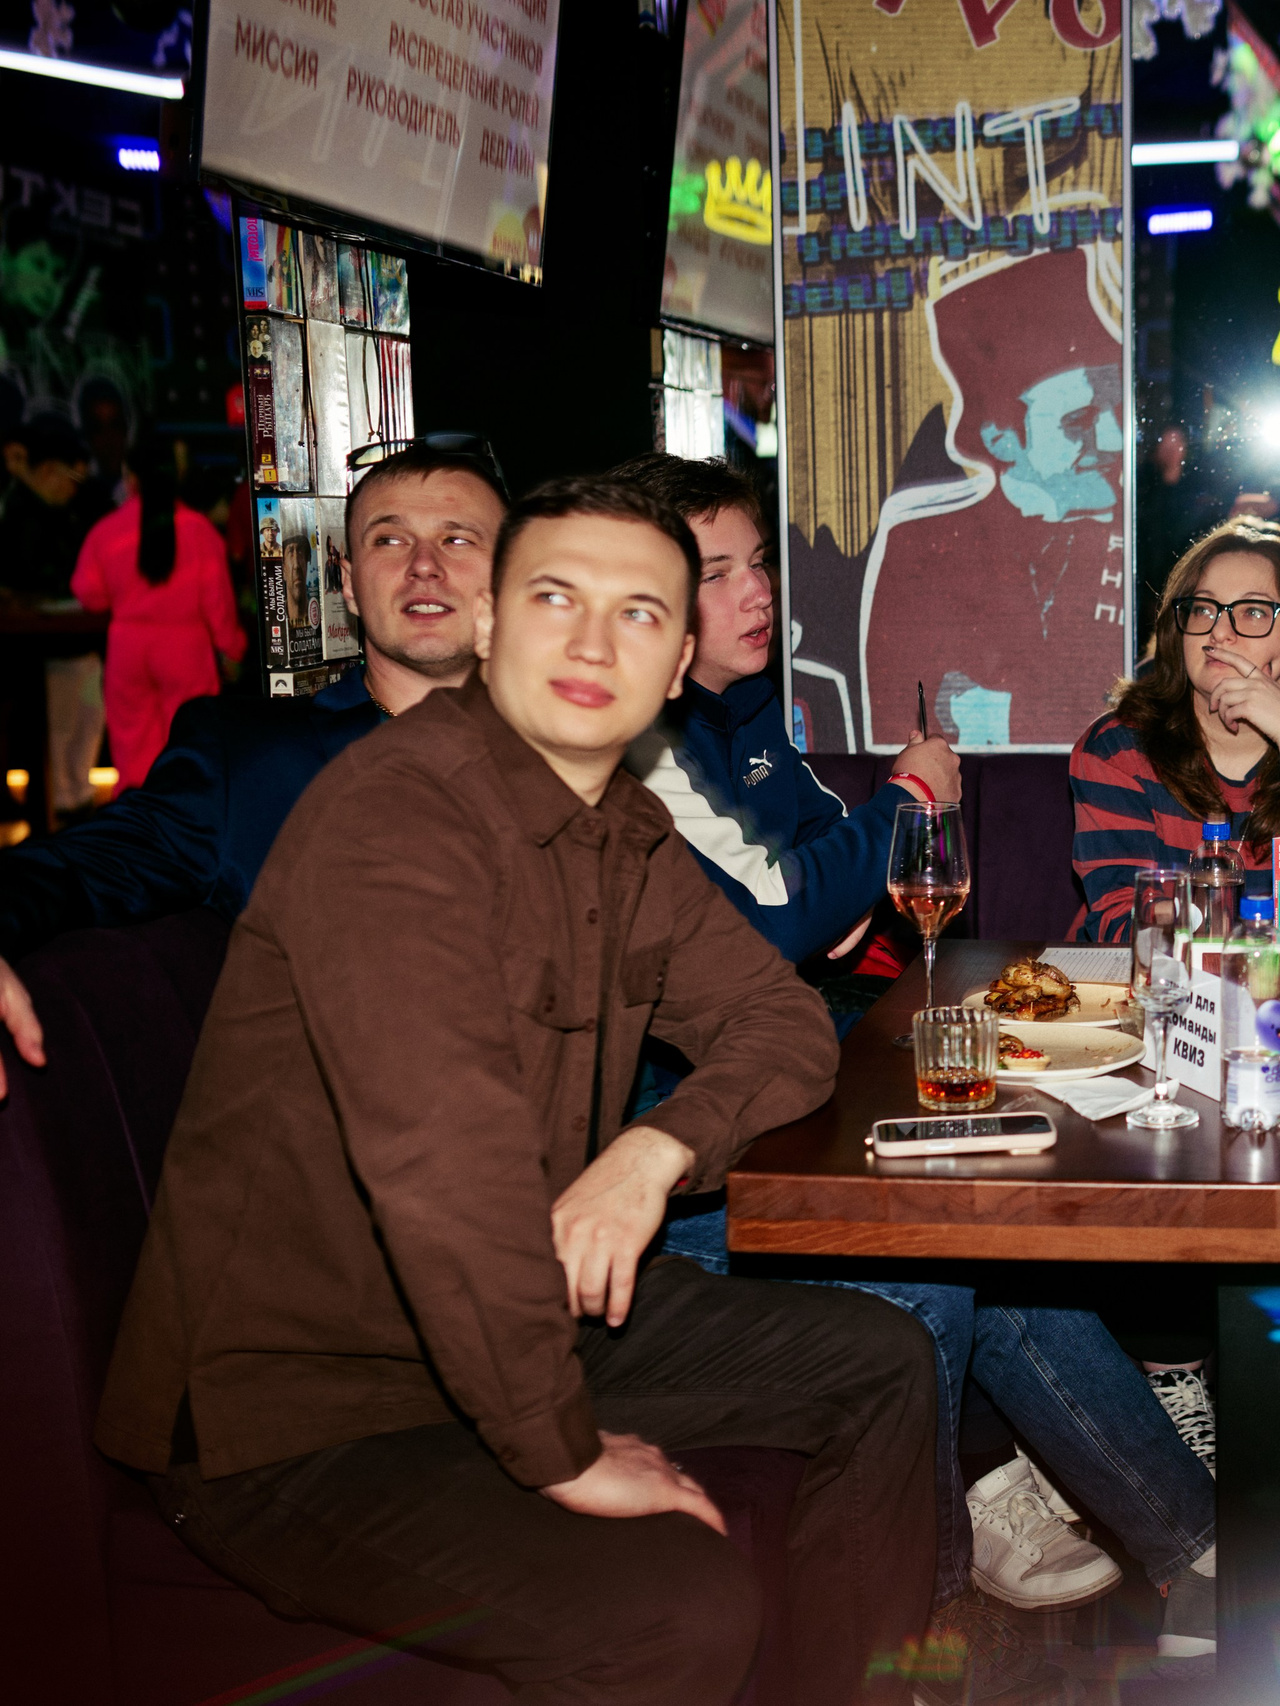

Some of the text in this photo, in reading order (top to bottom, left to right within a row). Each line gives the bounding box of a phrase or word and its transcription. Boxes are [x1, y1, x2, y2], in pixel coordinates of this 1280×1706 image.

[235, 13, 319, 91] МИССИЯ
[389, 19, 500, 112] РАСПРЕДЕЛЕНИЕ
[347, 63, 461, 149] РУКОВОДИТЕЛЬ
[841, 97, 1081, 240] INT
[274, 565, 285, 622] СОЛДАТАМИ
[743, 765, 769, 788] PUMA
[1195, 994, 1216, 1015] для
[1173, 1037, 1206, 1068] КВИЗ
